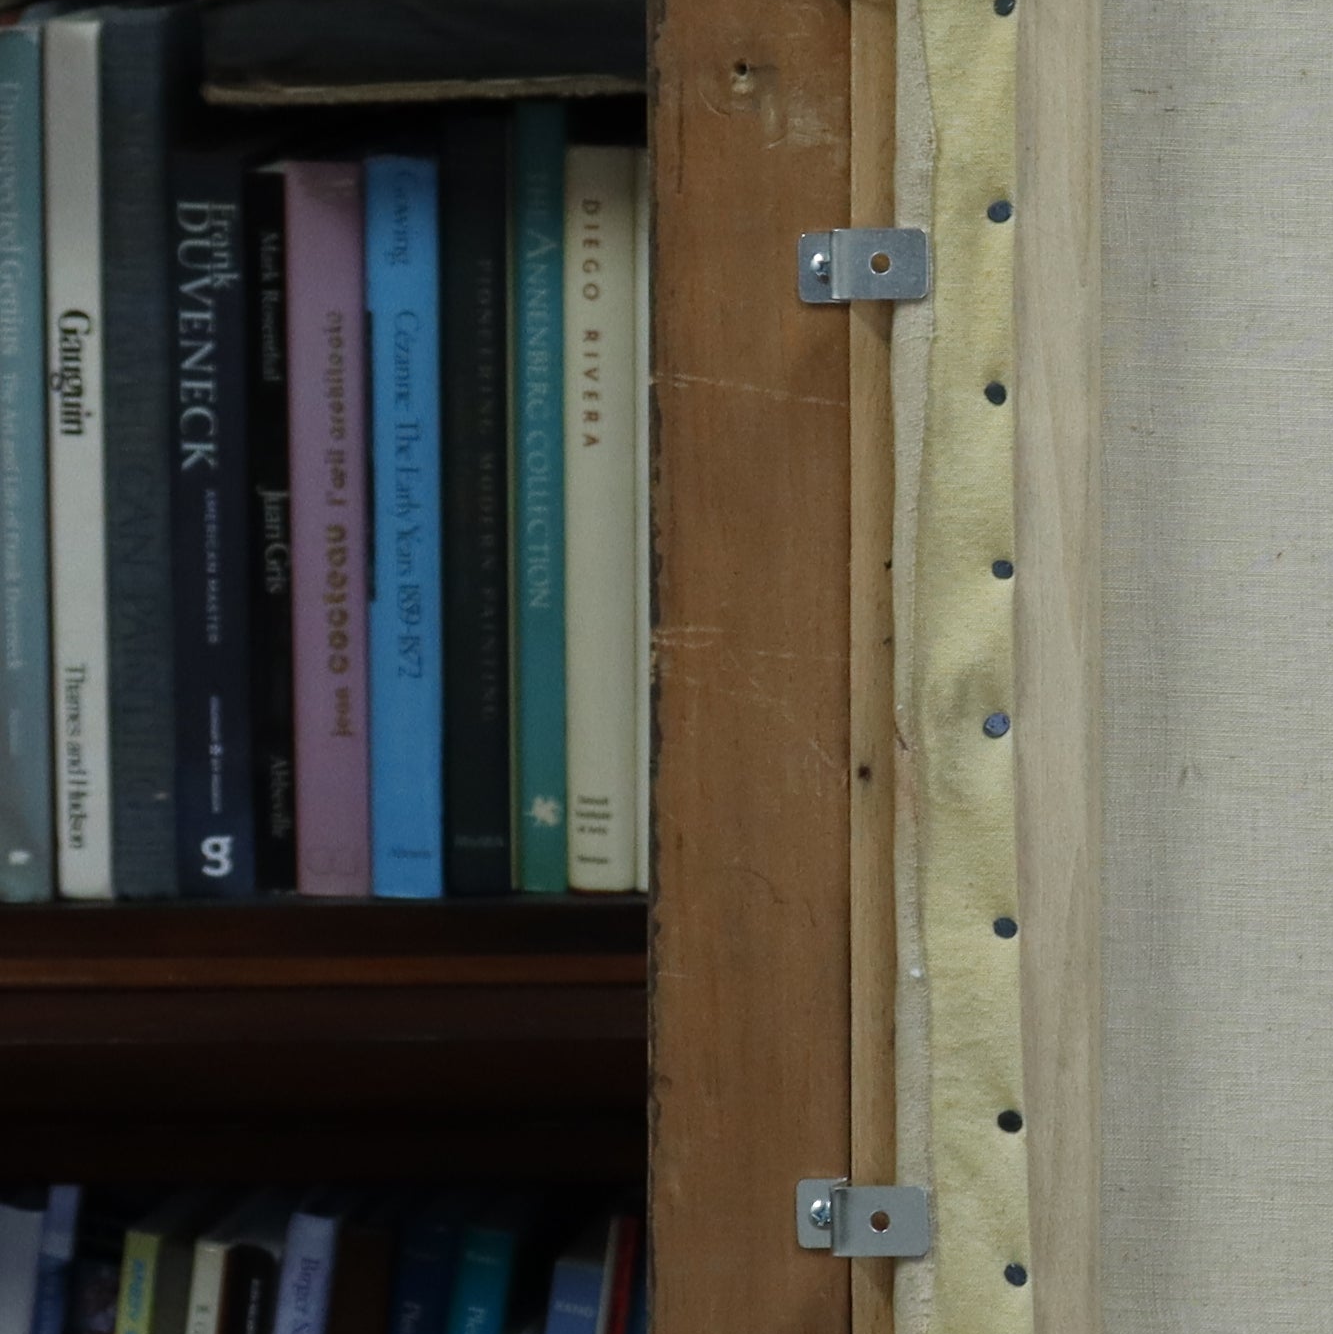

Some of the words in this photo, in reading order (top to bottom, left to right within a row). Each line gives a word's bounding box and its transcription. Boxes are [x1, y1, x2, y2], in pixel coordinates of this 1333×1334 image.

[209, 201, 240, 289] Frank
[260, 230, 279, 282] Mark
[583, 198, 600, 301] DIEGO
[176, 200, 218, 472] DUVENECK
[261, 289, 281, 382] Rosenthal
[525, 228, 556, 420] ANNENBERG
[50, 309, 93, 437] Gauguin
[583, 330, 601, 447] RIVERA
[396, 417, 422, 459] The
[204, 489, 219, 574] AMERICAN
[256, 485, 289, 539] Juan
[393, 467, 421, 517] Early
[525, 428, 548, 609] COLLECTION
[265, 543, 289, 594] Gris
[397, 525, 421, 576] Years
[206, 579, 219, 643] MASTER
[323, 524, 349, 675] cocteau
[65, 665, 87, 737] Thames
[67, 742, 89, 776] and
[269, 756, 289, 838] Abbeville
[69, 779, 90, 849] Hudson
